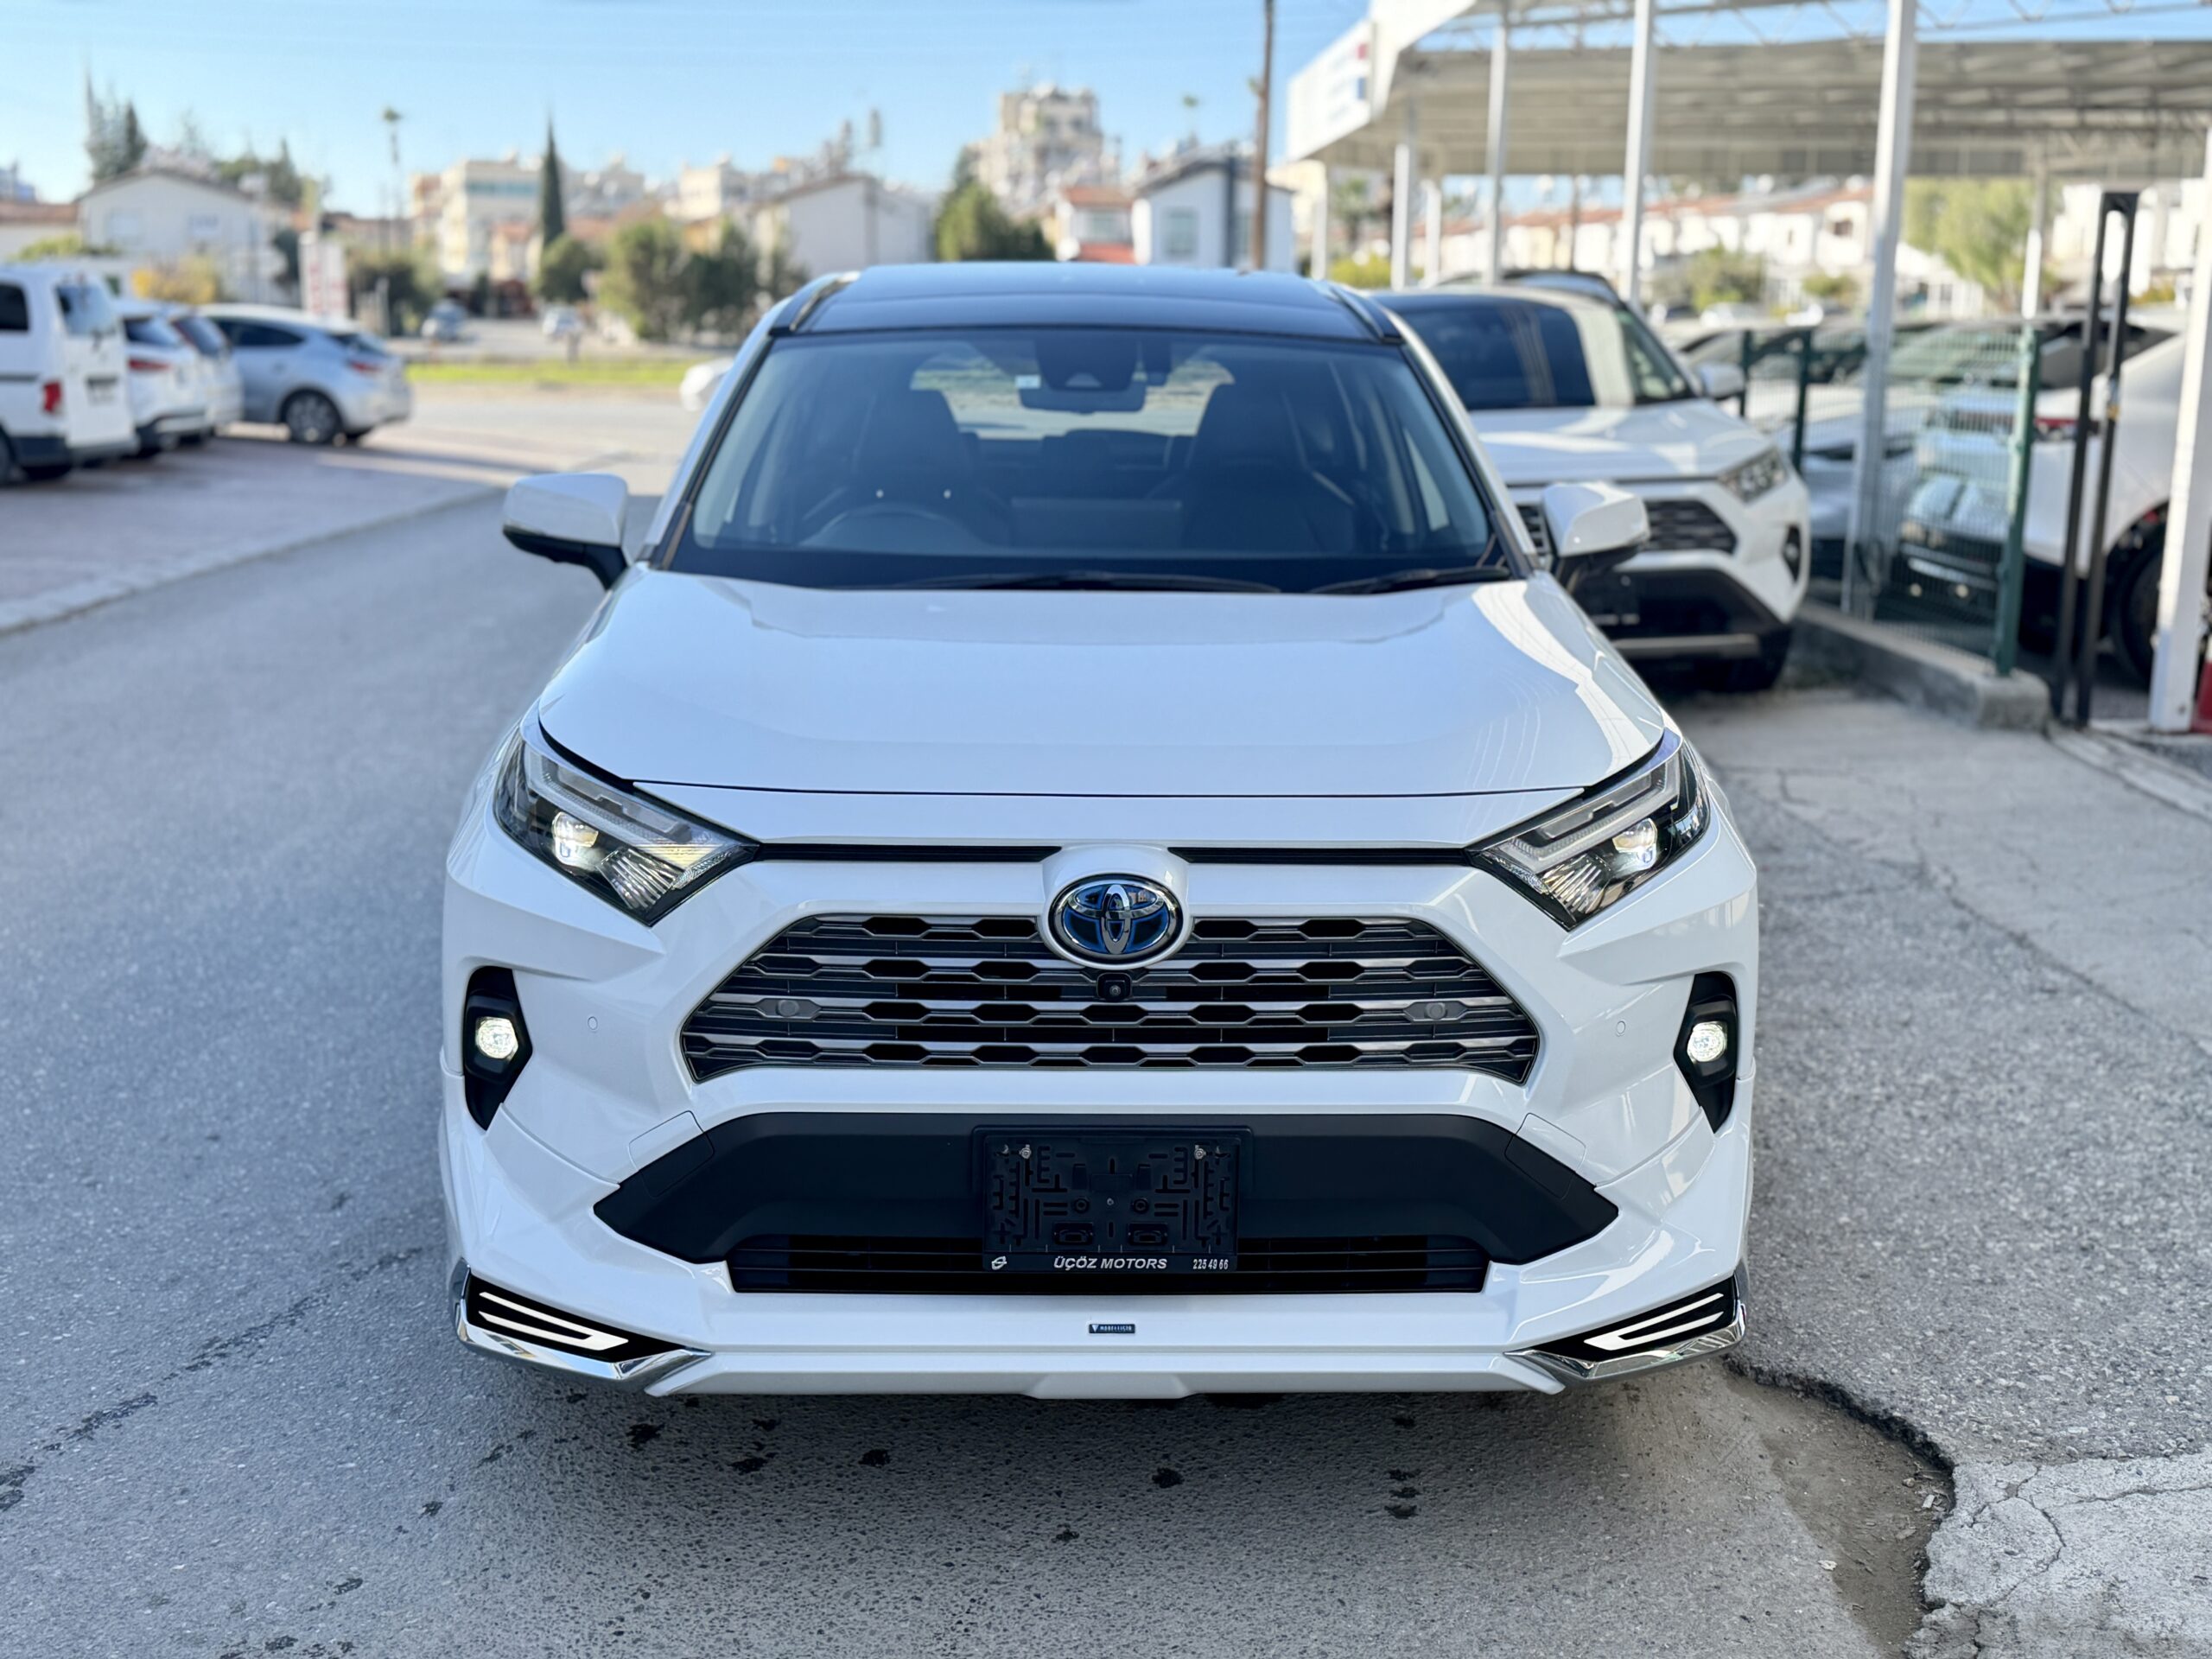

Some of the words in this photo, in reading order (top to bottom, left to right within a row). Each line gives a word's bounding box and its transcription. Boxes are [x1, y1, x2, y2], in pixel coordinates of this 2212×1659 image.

[1054, 1255, 1097, 1270] ÜÇÖZ
[1100, 1258, 1167, 1268] MOTORS
[1192, 1258, 1207, 1269] 225
[1208, 1258, 1217, 1269] 49
